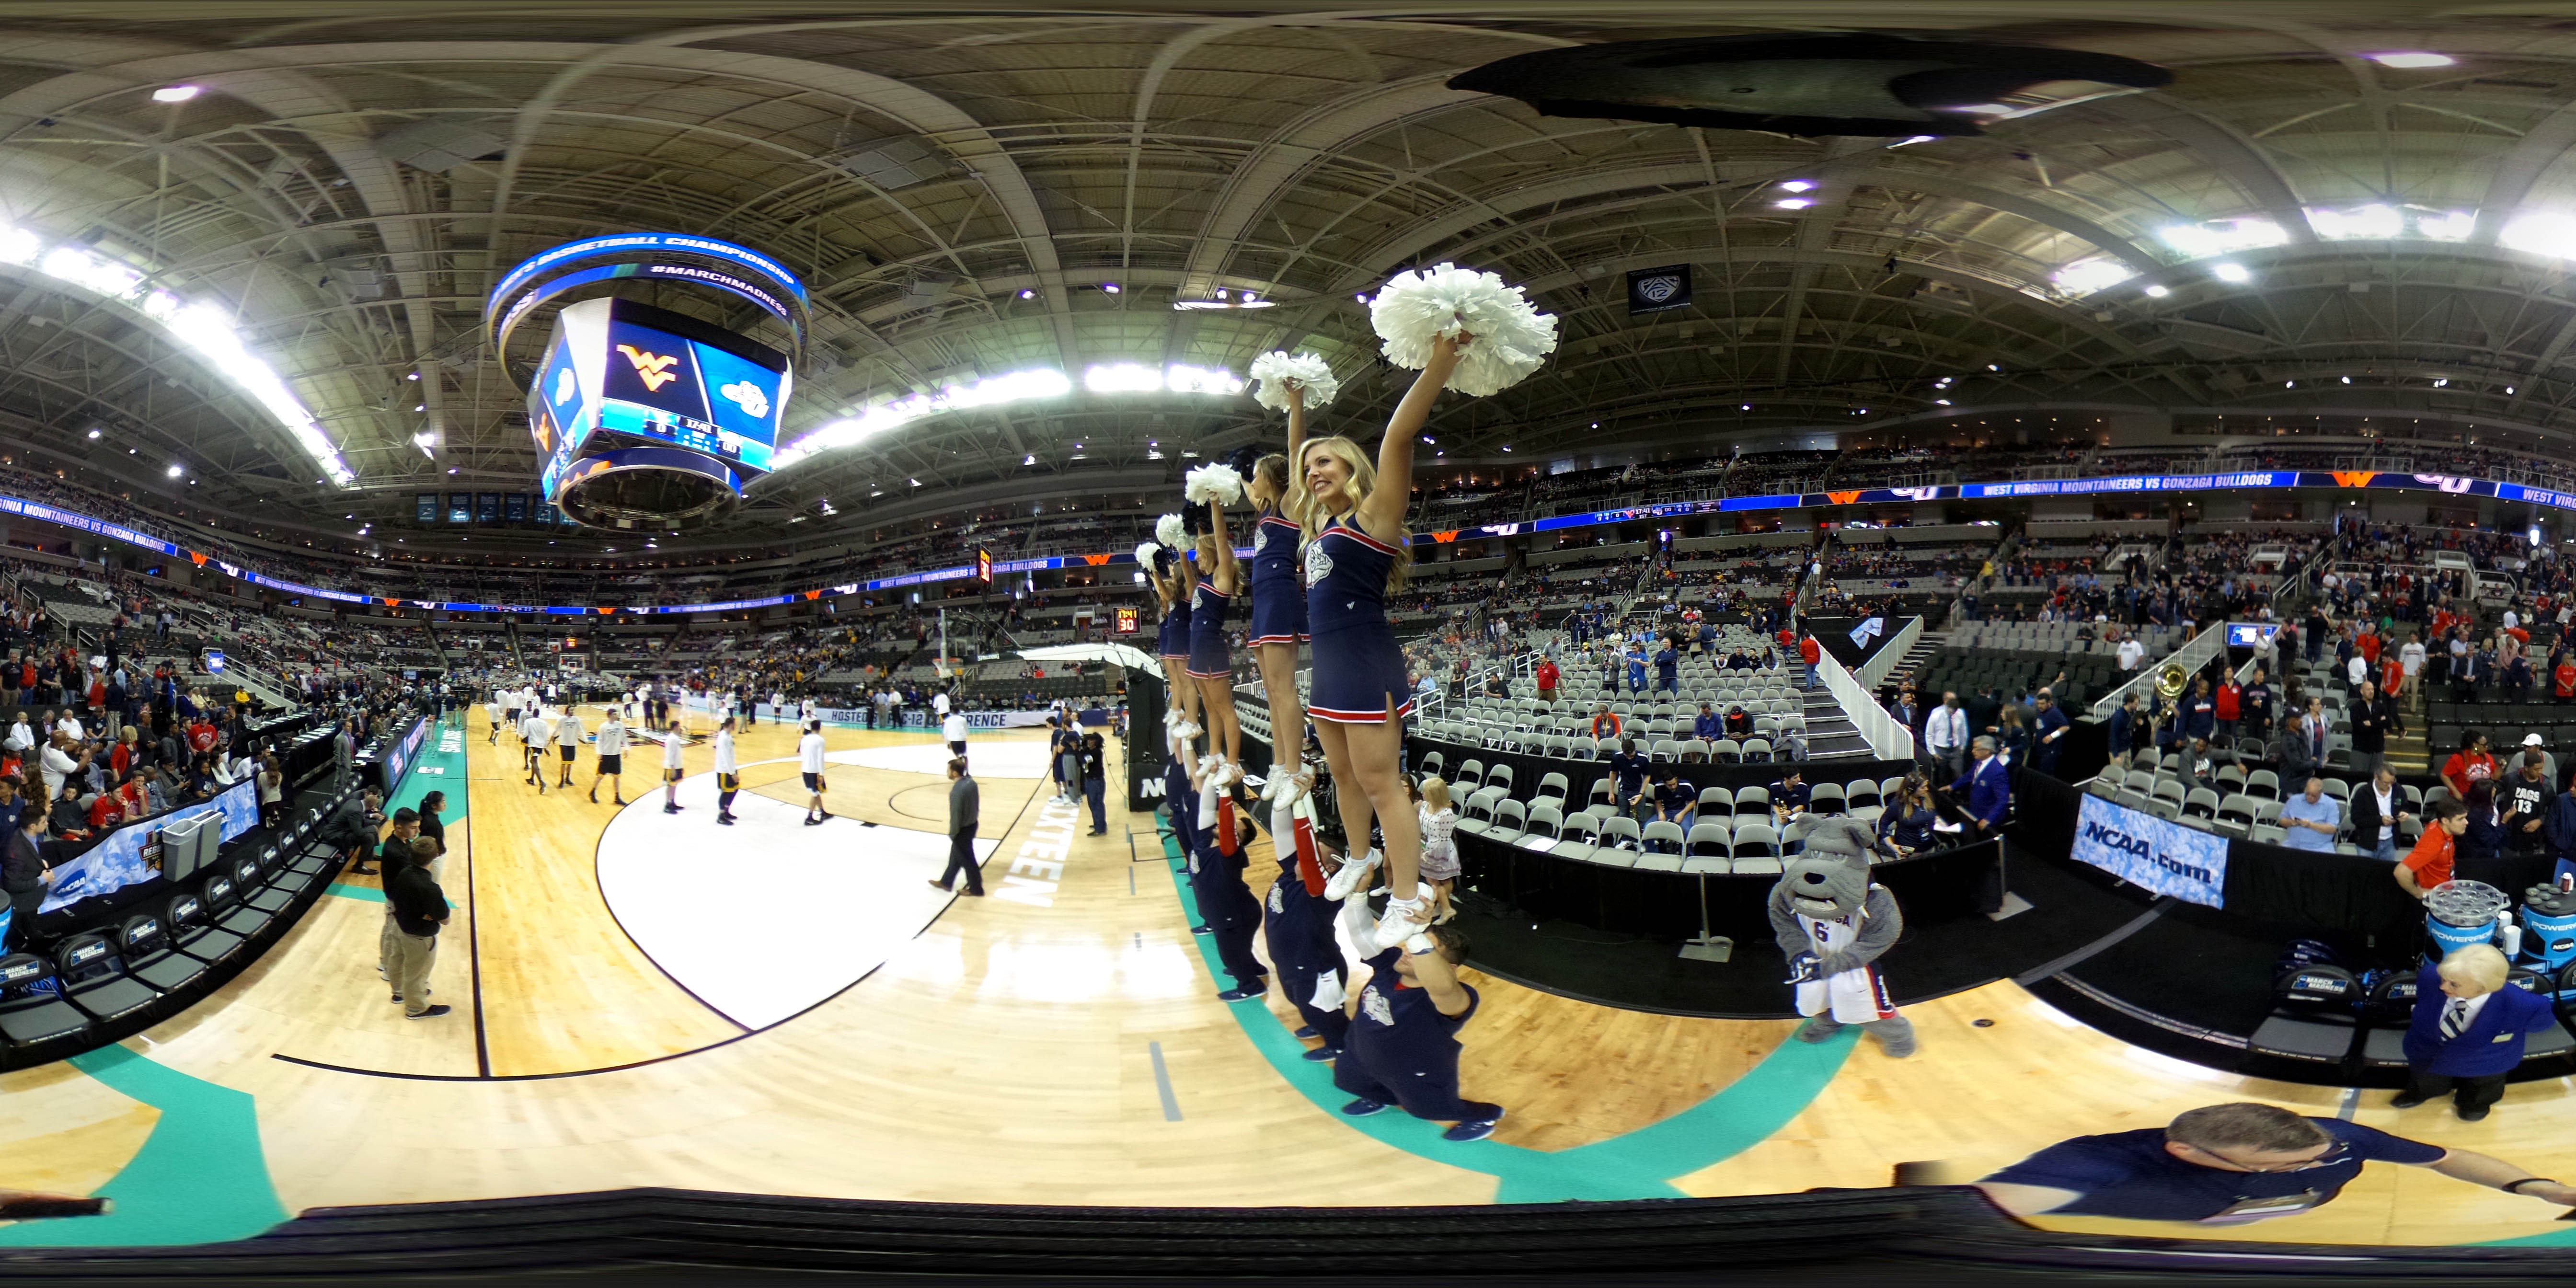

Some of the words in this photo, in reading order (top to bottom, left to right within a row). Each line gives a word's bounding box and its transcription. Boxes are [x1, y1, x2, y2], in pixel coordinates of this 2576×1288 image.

[664, 237, 794, 284] CHAMPIONSHIP
[650, 265, 787, 317] #MARCHMADNESS
[1983, 484, 2012, 496] WEST
[2013, 482, 2059, 494] VIRGINIA
[2060, 478, 2143, 492] MOUNTAINEERS
[2145, 478, 2160, 489] VS
[2162, 477, 2212, 489] GONZAGA
[2214, 474, 2272, 488] BULLDOGS
[2522, 489, 2554, 504] WEST
[23, 504, 89, 529] MOUNTAINEERS
[90, 520, 101, 531] VS
[102, 524, 134, 542] GONZAGA
[134, 533, 166, 552] BULLDOGS
[1234, 549, 1255, 558] GINIA
[880, 577, 895, 588] WEST
[896, 575, 920, 587] VIRGINIA
[920, 569, 968, 584] MOUNTAINEERS
[1012, 560, 1048, 570] BULLDOGS
[1118, 609, 1137, 619] 17:41
[1120, 619, 1134, 631] 30
[831, 711, 867, 724] HOSTED
[2515, 787, 2540, 803] ZAGS
[2518, 799, 2532, 814] 13
[2085, 820, 2211, 884] NCAA.com
[133, 924, 148, 934] MARCH
[136, 925, 157, 938] MADNESS
[1813, 921, 1829, 943] 6
[76, 945, 95, 955] MARCH
[2552, 942, 2575, 950] NCAA
[80, 948, 104, 960] MADNESS
[5, 965, 27, 975] MARCH
[8, 967, 38, 979] MADNESS
[2306, 977, 2333, 986] MARCH
[2308, 983, 2344, 993] MADNESS
